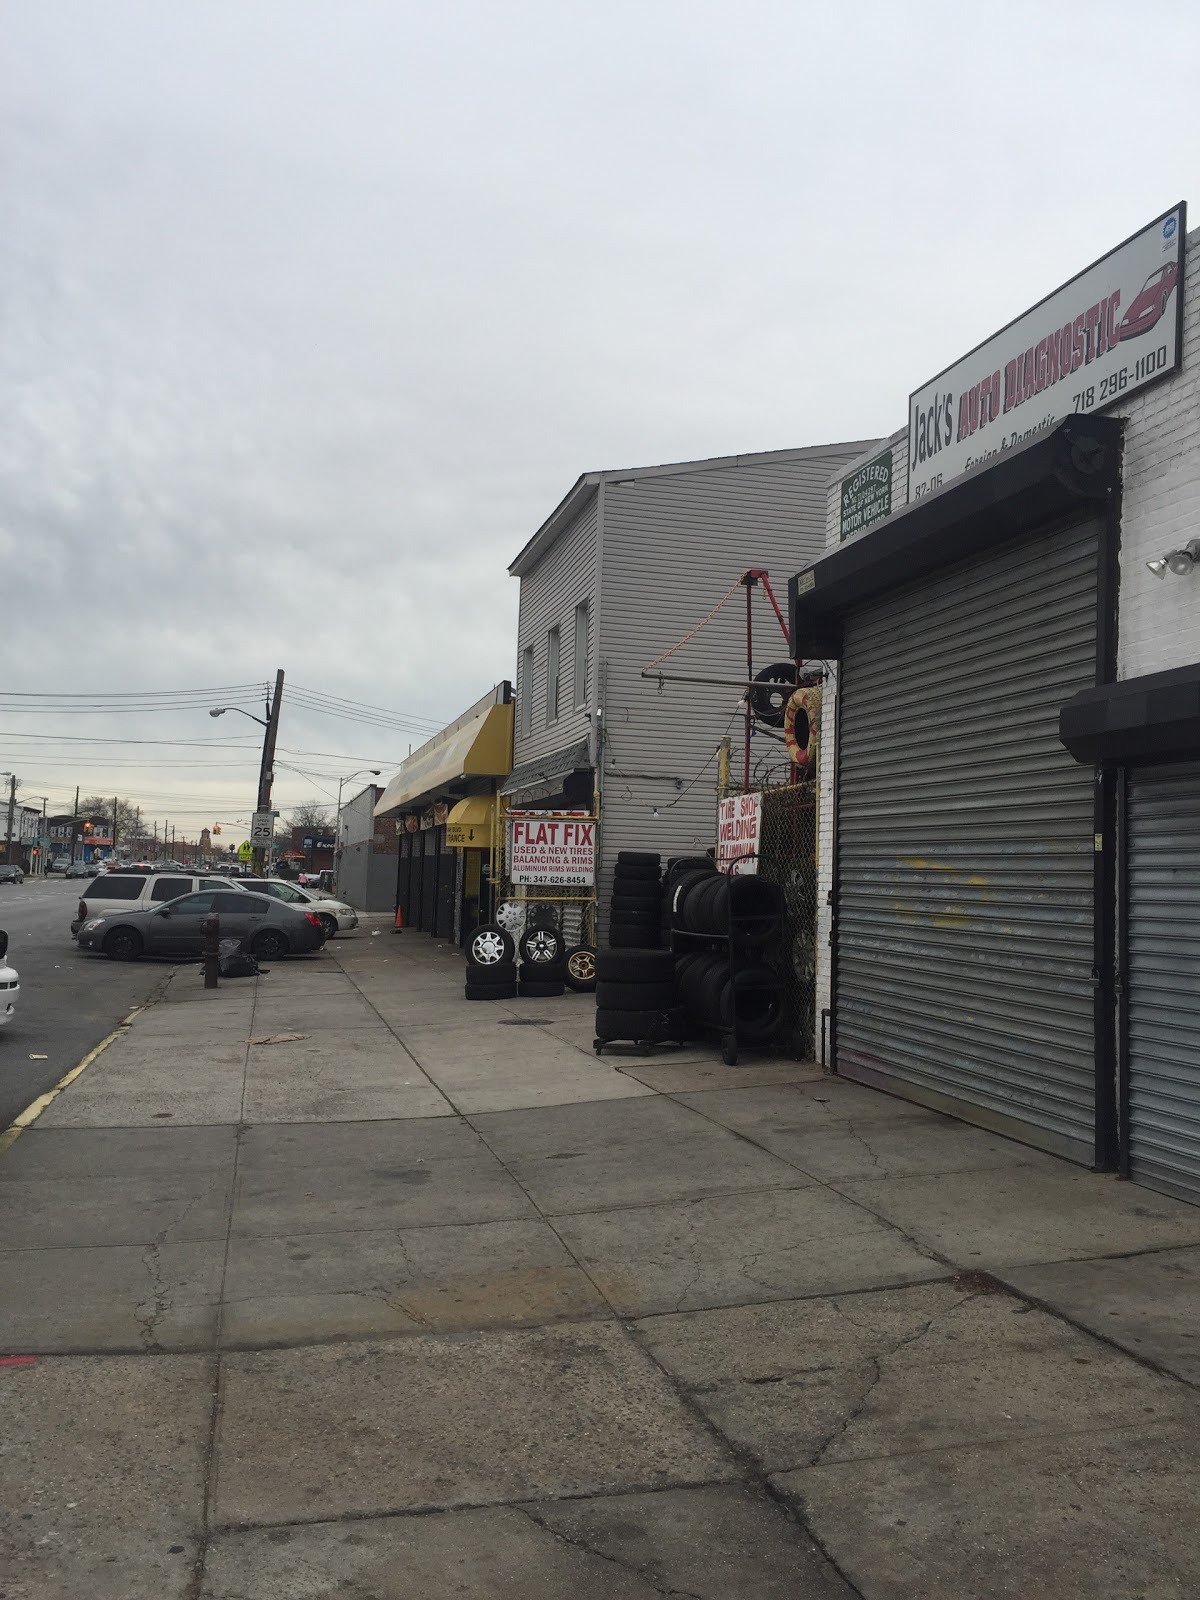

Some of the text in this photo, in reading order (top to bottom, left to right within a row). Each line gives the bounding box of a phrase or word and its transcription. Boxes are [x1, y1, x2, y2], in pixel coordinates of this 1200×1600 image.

[912, 288, 1121, 472] Jack's AUTO DIAGNOSTIC
[1073, 345, 1166, 414] 718 296-1100
[843, 465, 889, 507] REGISTERED
[843, 484, 889, 517] STATE OF NEW YORK
[842, 511, 862, 534] MOTOR
[863, 494, 889, 521] VEHICLE
[720, 796, 758, 820] TIRE SHOP
[254, 826, 271, 837] 25
[514, 822, 593, 846] FLAT FIX
[719, 816, 757, 842] WELDING
[513, 855, 593, 865] BALANCING & RIMS
[514, 846, 593, 856] USED & NEW TIRES
[519, 875, 586, 884] PH: 347-626-8454
[549, 865, 565, 873] RIMS
